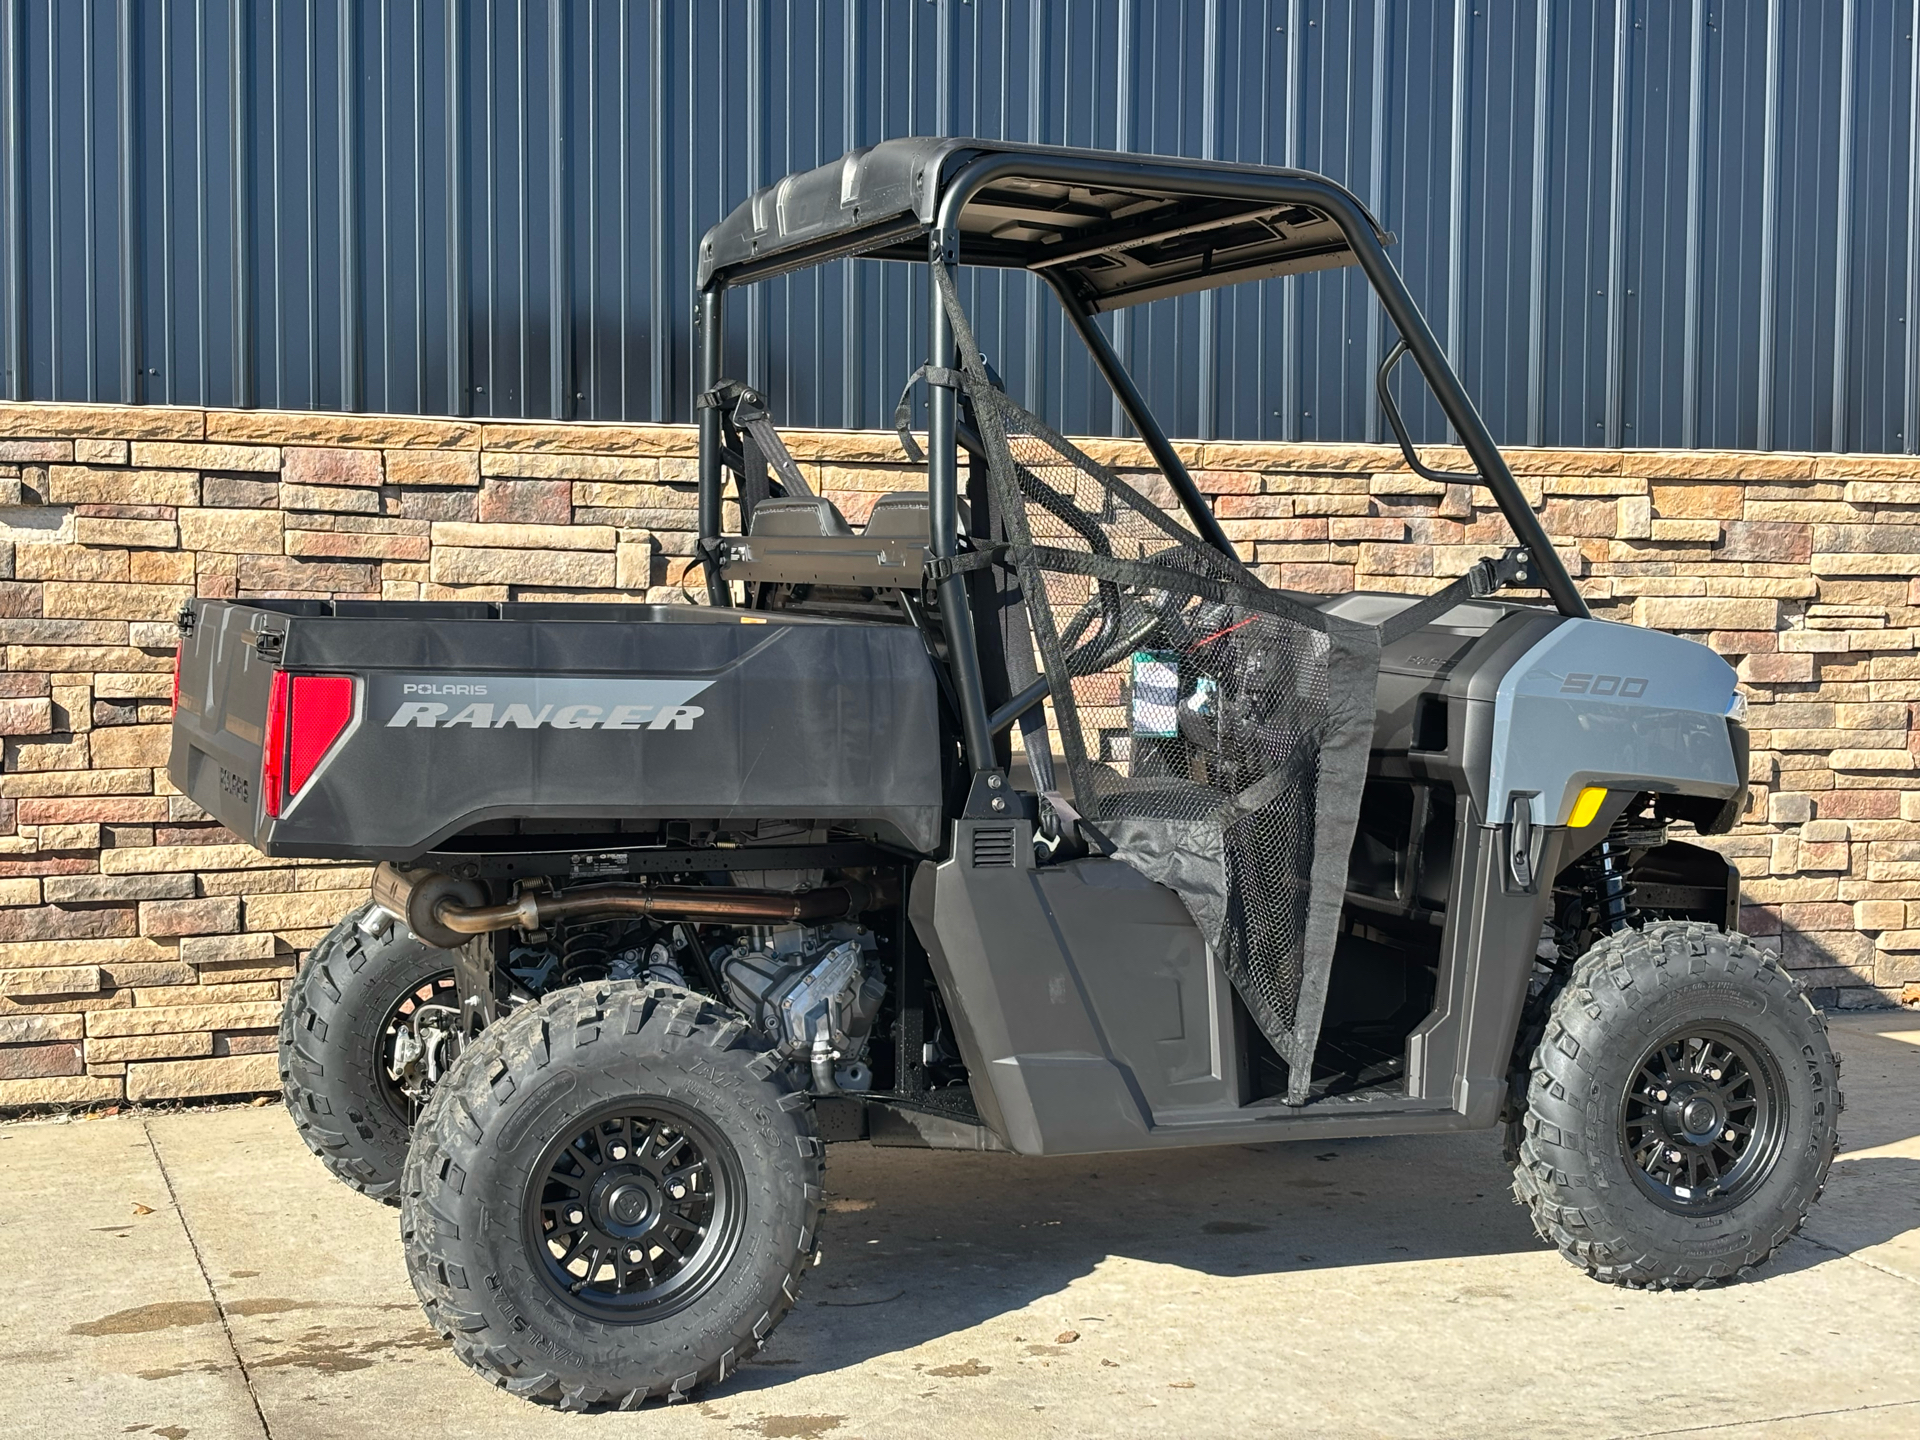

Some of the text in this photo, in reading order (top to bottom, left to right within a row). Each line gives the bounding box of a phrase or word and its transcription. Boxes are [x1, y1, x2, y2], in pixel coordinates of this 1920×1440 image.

[403, 683, 488, 696] POLARIS
[1559, 672, 1649, 698] 500
[384, 701, 705, 730] RANGER
[1801, 1044, 1825, 1158] CARLSTAR
[484, 1271, 584, 1369] CARLSTAR
